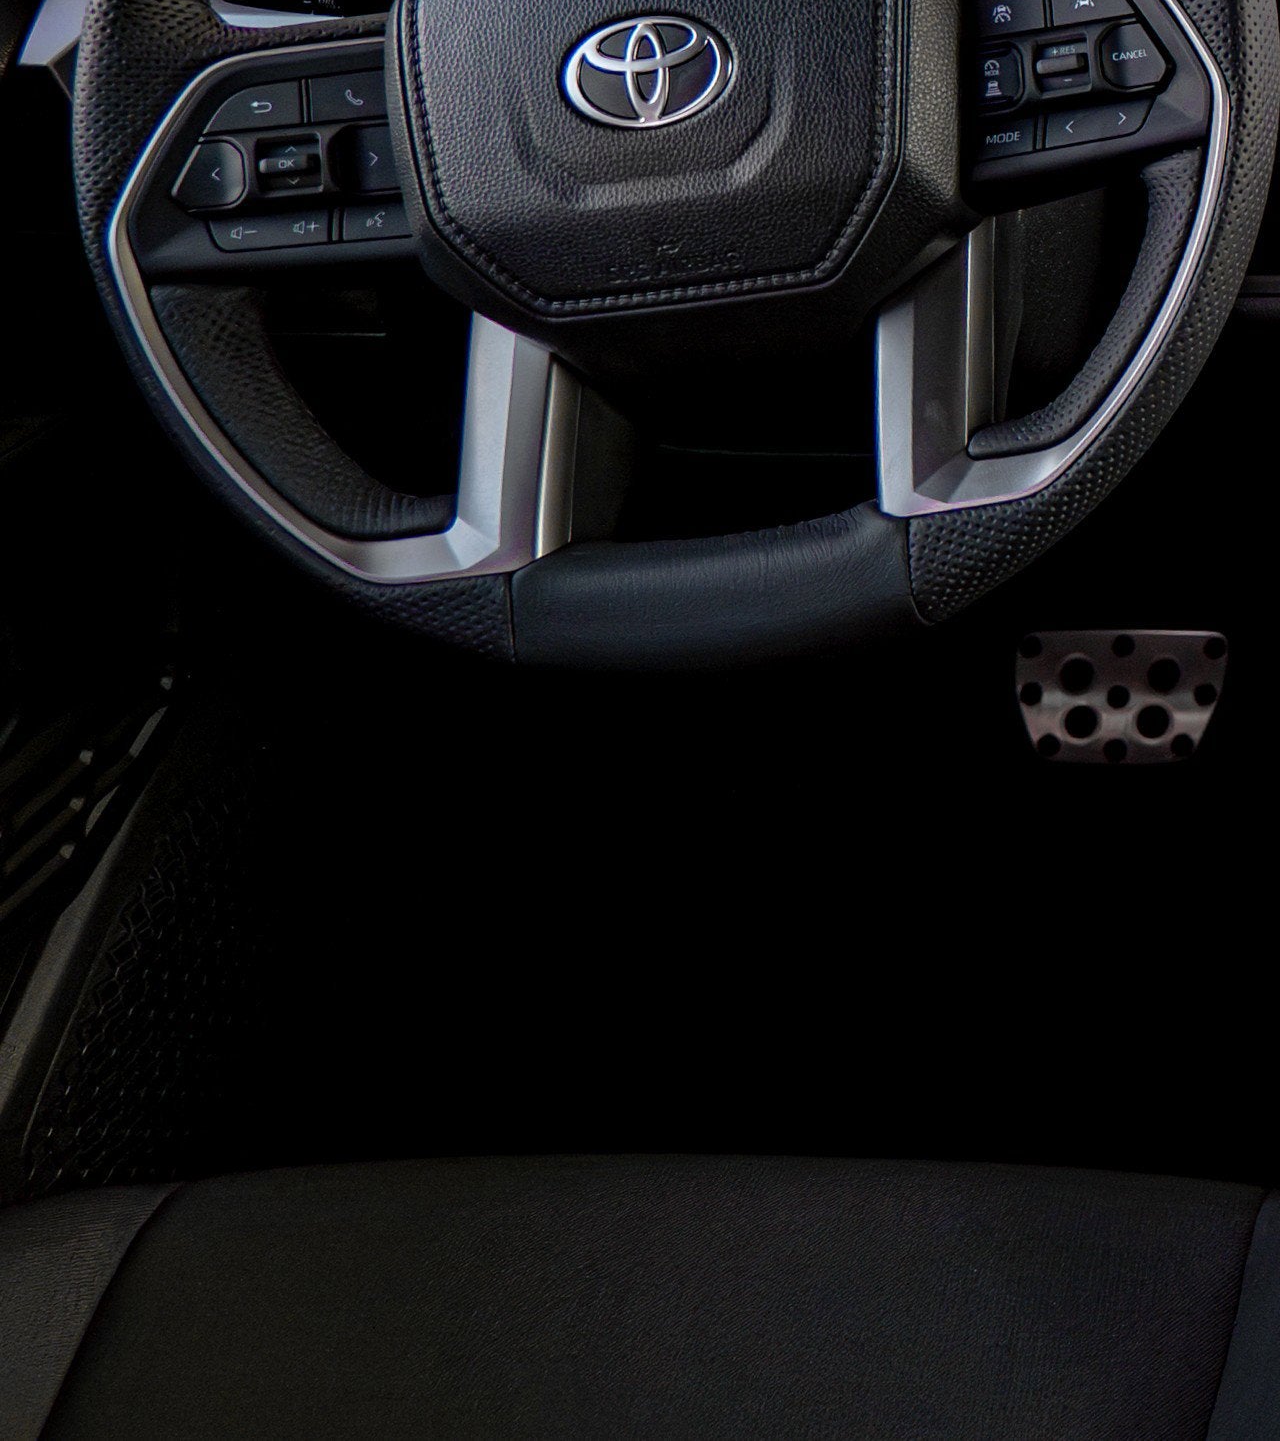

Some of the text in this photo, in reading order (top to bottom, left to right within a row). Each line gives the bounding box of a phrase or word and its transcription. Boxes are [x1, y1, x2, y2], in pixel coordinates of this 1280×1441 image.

[1112, 48, 1147, 61] CANCEL
[986, 131, 1021, 145] MODE
[277, 159, 295, 169] OK
